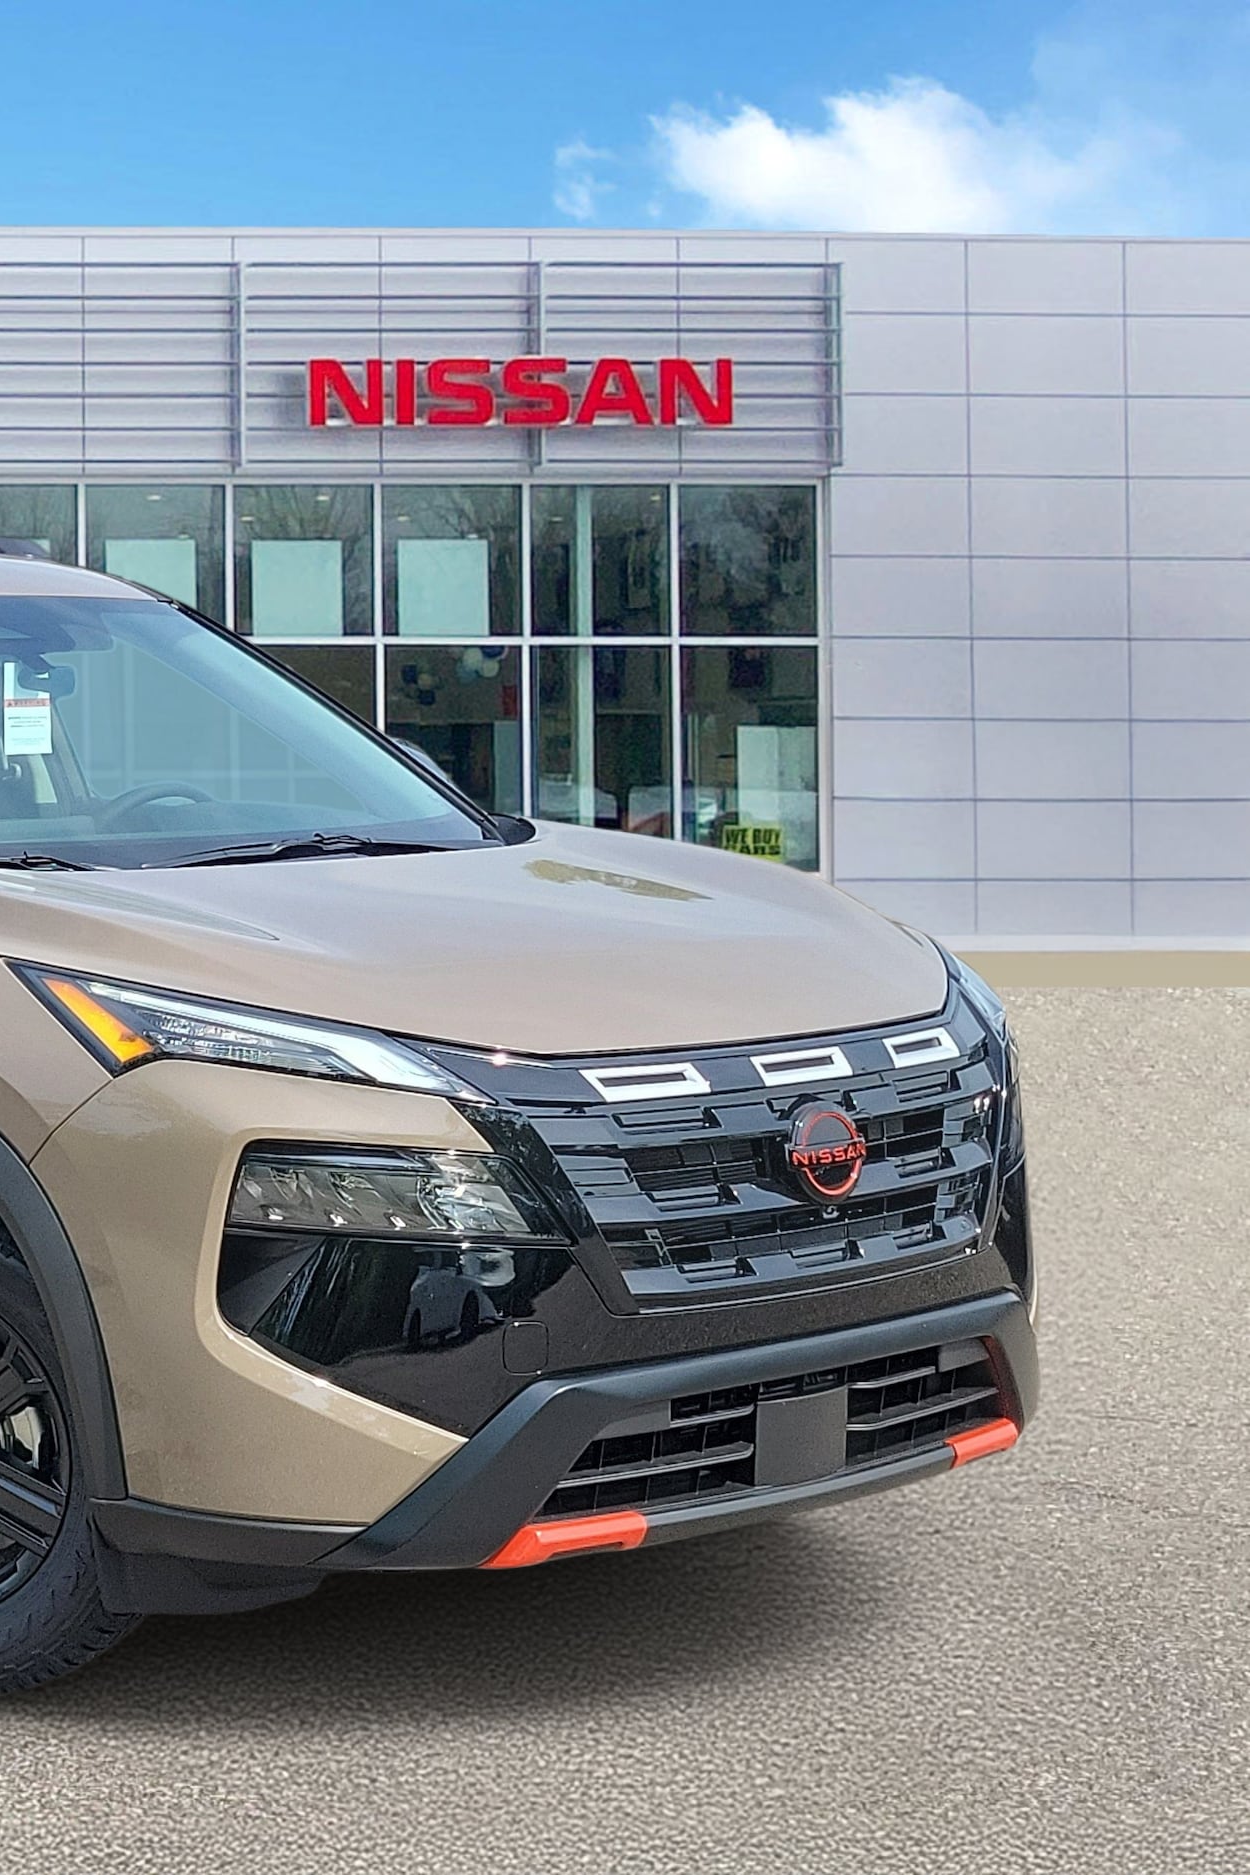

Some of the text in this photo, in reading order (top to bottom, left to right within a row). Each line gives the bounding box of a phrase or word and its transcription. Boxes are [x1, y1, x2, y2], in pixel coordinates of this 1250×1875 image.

[307, 356, 735, 428] NISSAN
[725, 828, 781, 845] WE BUY
[791, 1139, 866, 1166] NISSAN
